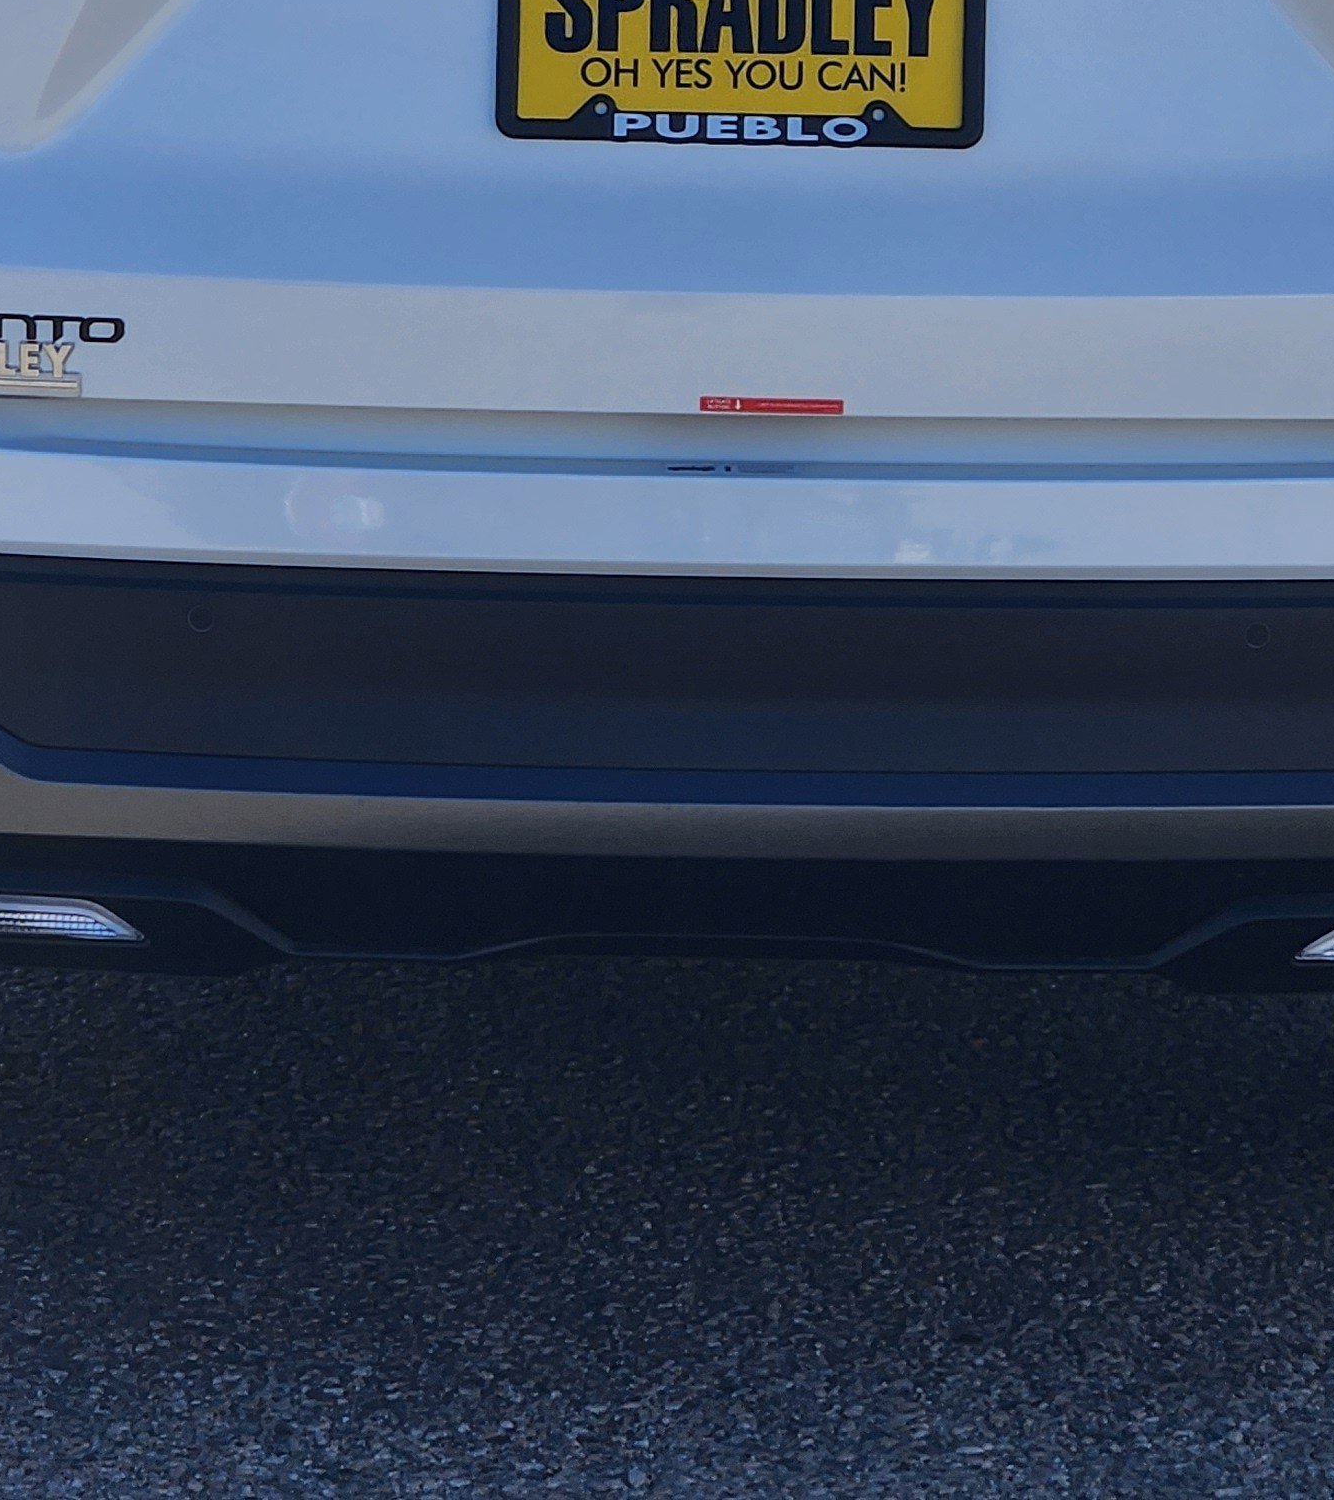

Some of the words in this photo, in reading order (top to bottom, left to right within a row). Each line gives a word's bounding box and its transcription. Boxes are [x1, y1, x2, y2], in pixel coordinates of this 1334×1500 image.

[580, 57, 638, 88] OH
[652, 59, 713, 90] YES
[728, 60, 805, 91] YOU
[818, 61, 907, 93] CAN!
[612, 113, 870, 143] PUEBLO
